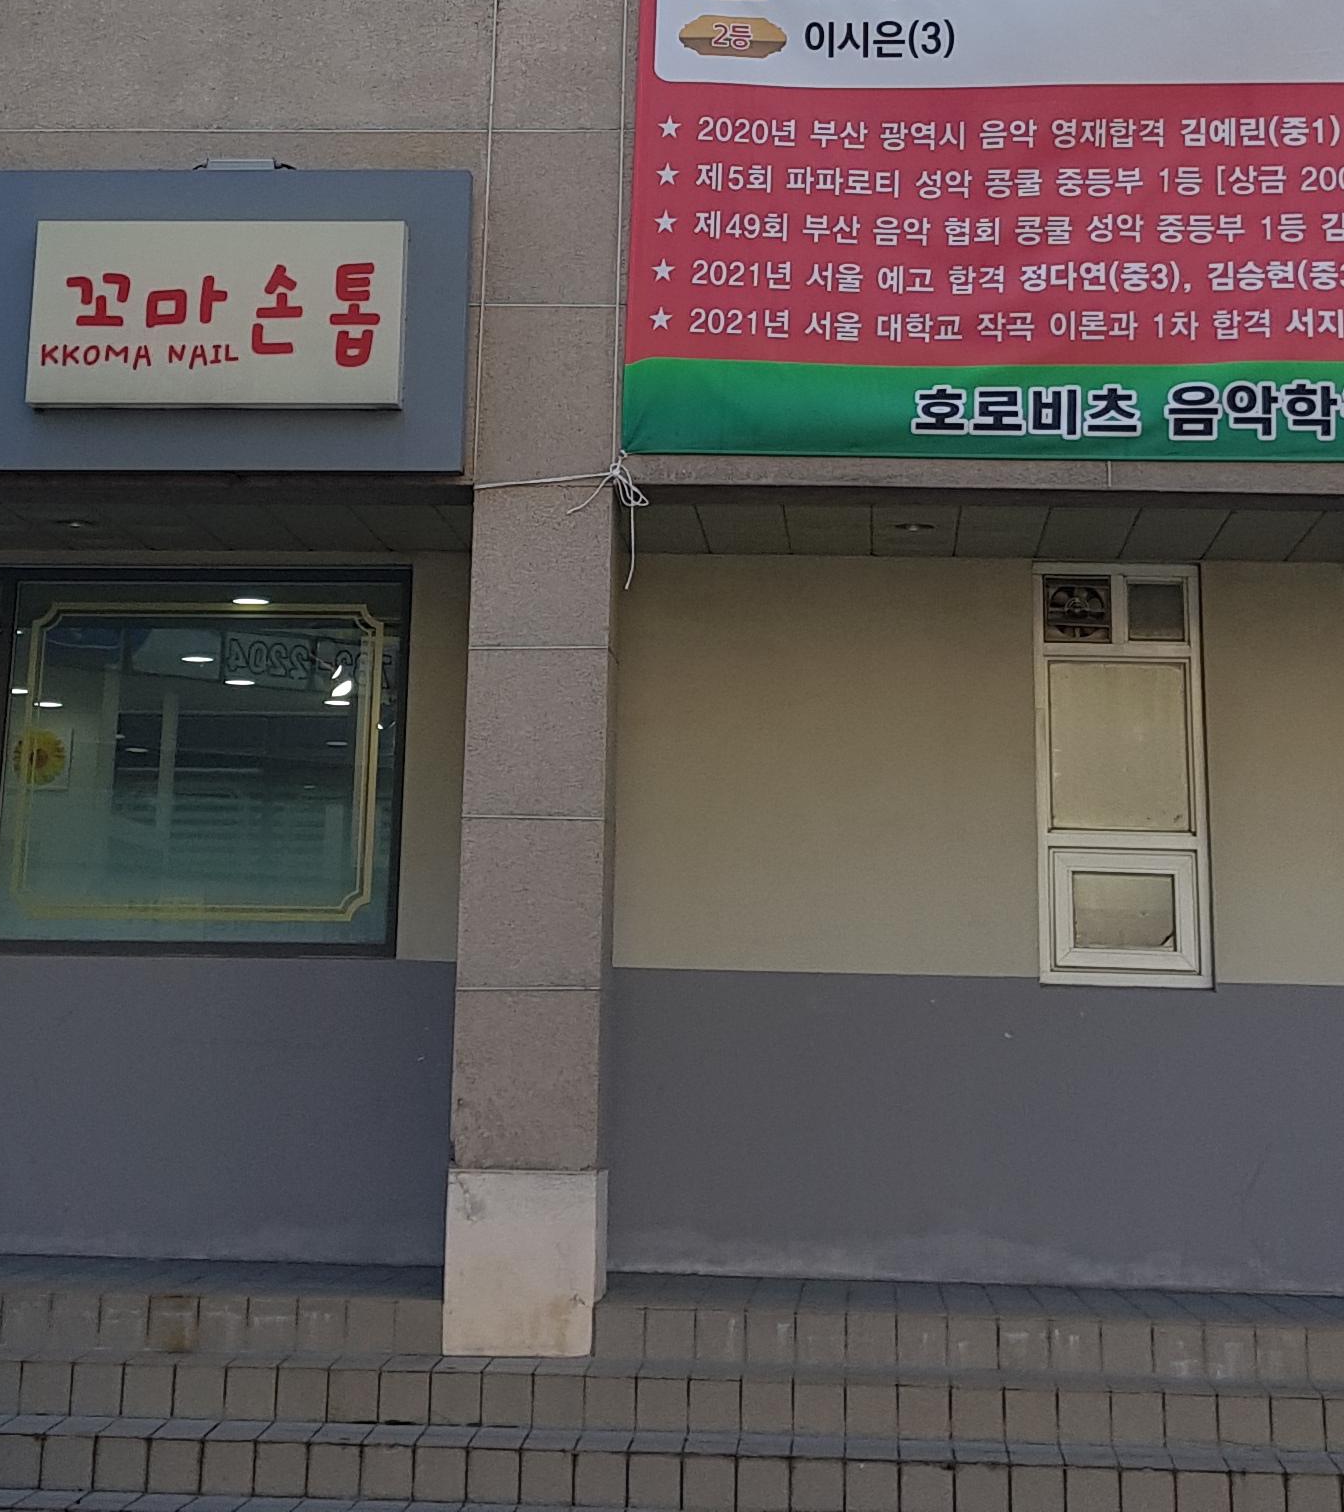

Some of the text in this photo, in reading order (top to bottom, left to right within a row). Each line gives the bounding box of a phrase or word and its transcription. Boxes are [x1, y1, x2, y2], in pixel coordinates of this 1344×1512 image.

[711, 23, 753, 50] 2등
[803, 17, 955, 63] 이시은(3)
[697, 114, 1342, 151] 2020년 부산 광역시 음악 영재합격 김예린(중1)
[694, 162, 774, 194] 제5회
[785, 167, 901, 198] 파파로티
[914, 168, 973, 199] 성악
[983, 168, 1044, 197] 콩쿨
[1055, 165, 1145, 197] 중등부
[1157, 166, 1202, 195] 1등
[1215, 164, 1288, 196] [상금
[693, 209, 789, 242] 제49회
[801, 214, 861, 246] 부산
[871, 214, 931, 246] 음악
[943, 216, 1002, 246] 협회
[1012, 215, 1073, 245] 콩쿨
[1085, 213, 1144, 243] 성악
[1156, 212, 1246, 245] 중등부
[1260, 213, 1307, 243] 1등
[691, 259, 793, 291] 2021년
[805, 262, 865, 293] 서울
[876, 263, 935, 294] 예고
[947, 263, 1006, 295] 합격
[1018, 259, 1192, 293] 정다연(중3),
[688, 308, 791, 340] 2021년
[804, 310, 863, 342] 서울
[876, 312, 963, 343] 대학교
[976, 310, 1036, 343] 작곡
[1049, 308, 1139, 341] 이론과
[1151, 311, 1200, 341] 1차
[1212, 308, 1272, 340] 합격
[40, 343, 239, 369] KKOMA NAIL
[910, 386, 1139, 438] 호로비츠
